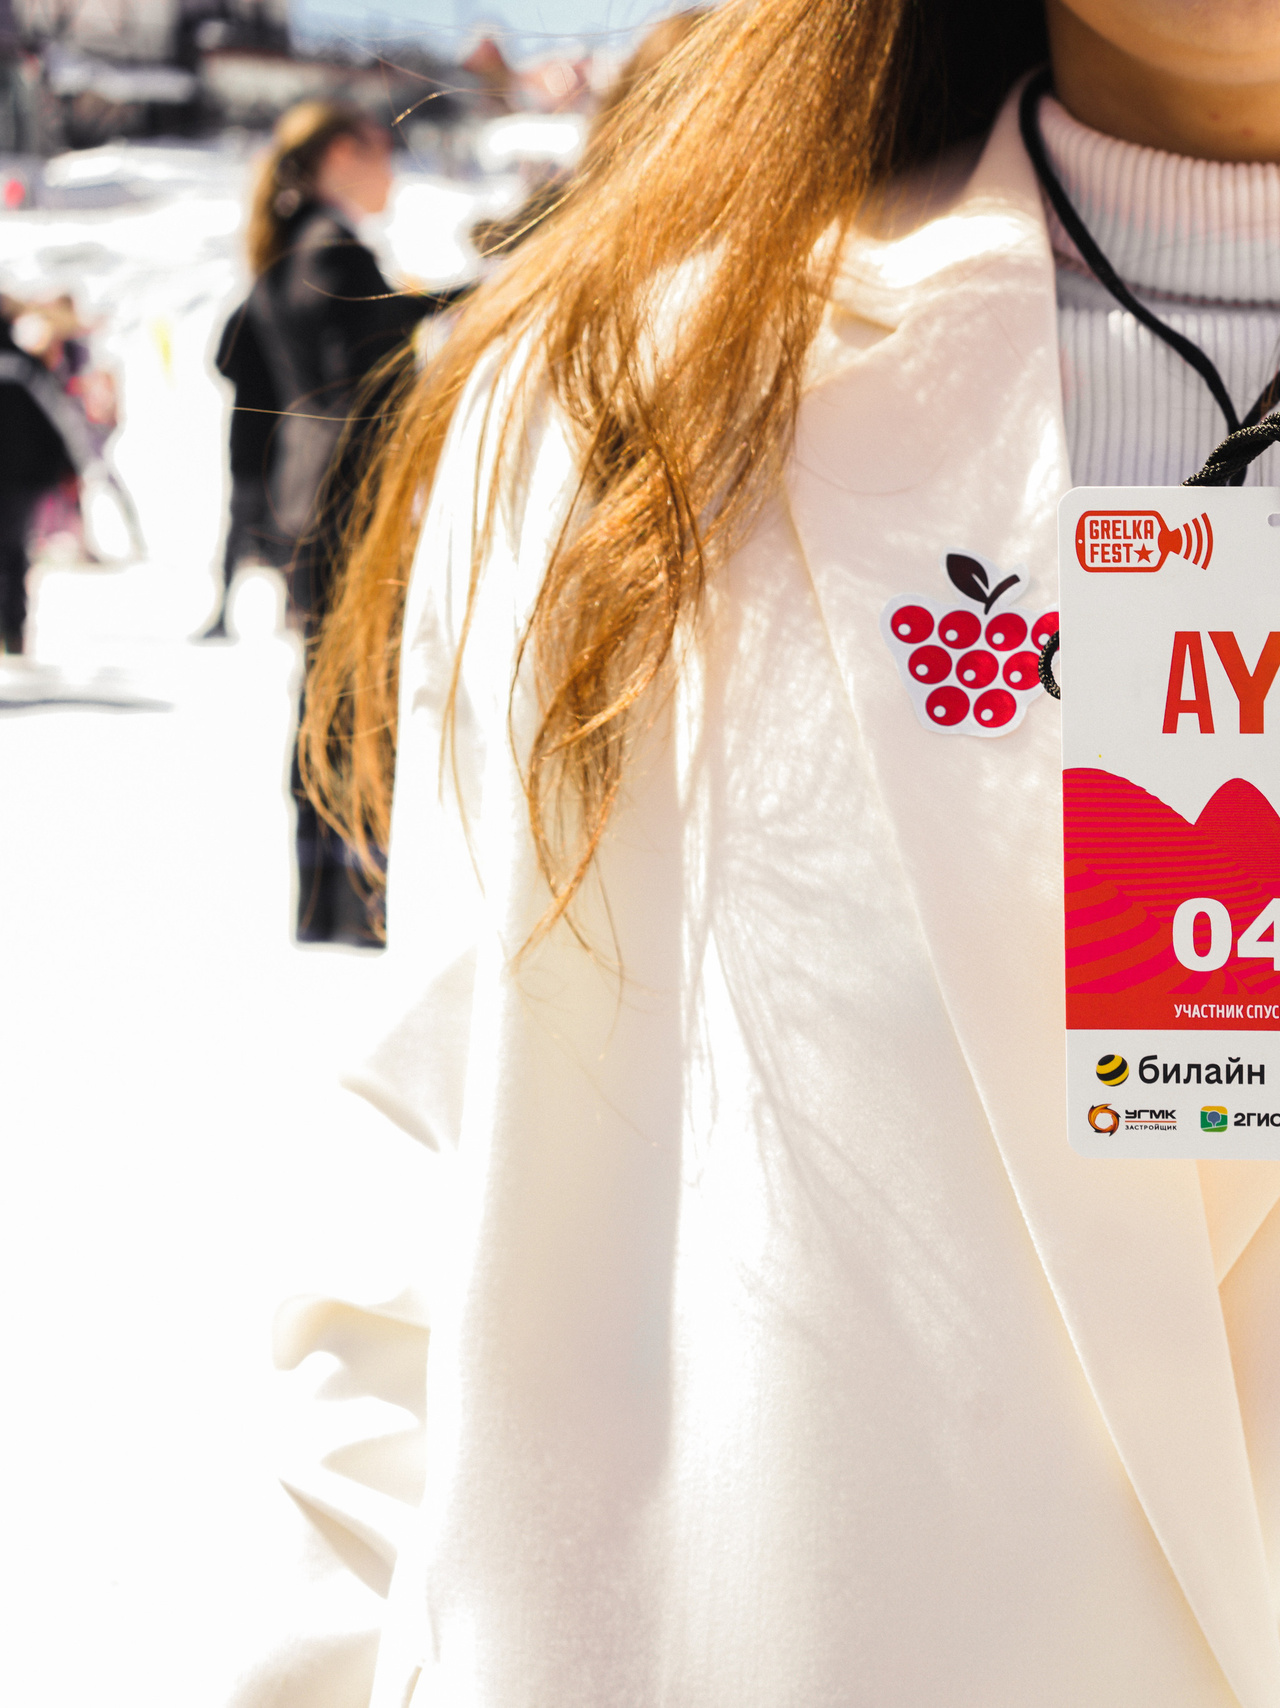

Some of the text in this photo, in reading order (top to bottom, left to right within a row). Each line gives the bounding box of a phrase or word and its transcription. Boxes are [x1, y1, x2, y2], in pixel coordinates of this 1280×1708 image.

[1089, 519, 1154, 541] GRELKA
[1090, 543, 1134, 564] FEST
[1174, 1004, 1244, 1019] УЧАСТНИК
[1138, 1054, 1265, 1085] билайн
[1125, 1109, 1177, 1120] УГМК
[1125, 1123, 1178, 1131] ЗАСТРОЙЩИК
